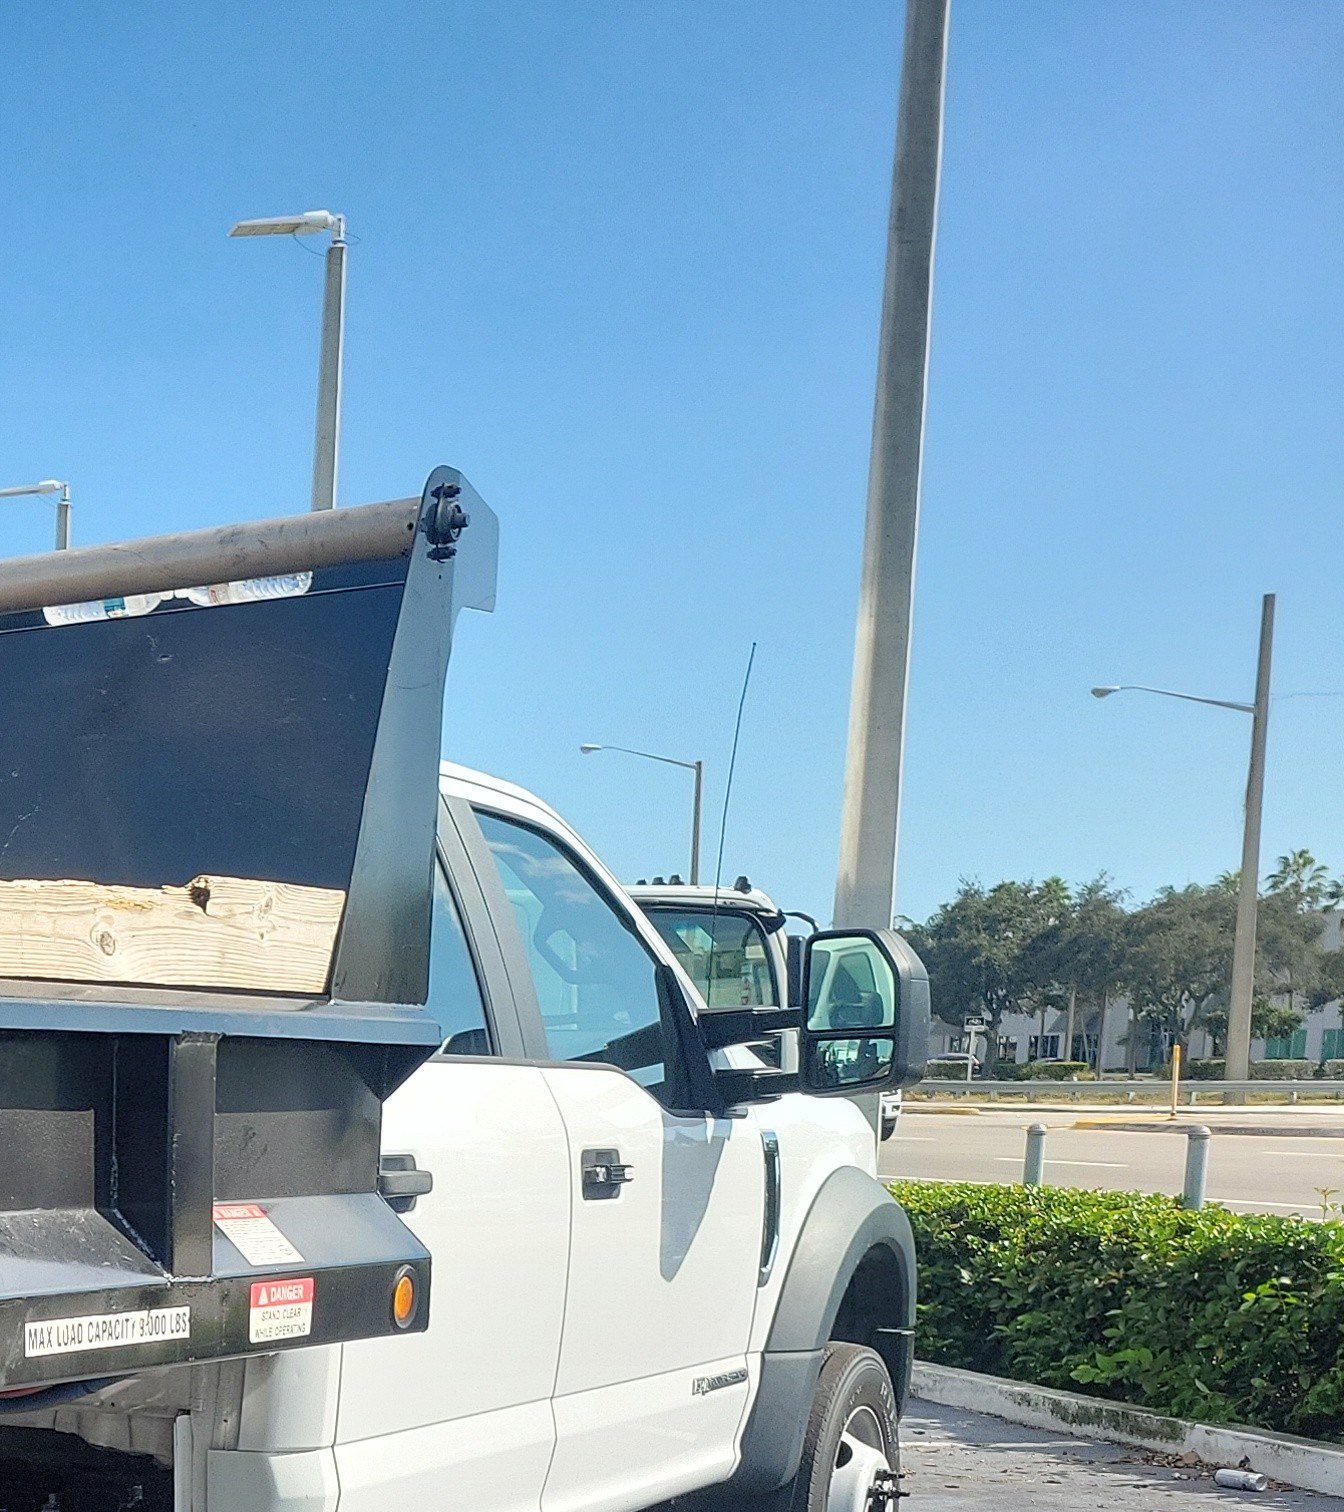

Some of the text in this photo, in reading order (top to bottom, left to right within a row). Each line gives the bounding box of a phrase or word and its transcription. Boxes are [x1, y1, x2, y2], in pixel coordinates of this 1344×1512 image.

[270, 1285, 304, 1302] DANGER
[261, 1308, 301, 1322] STAND CLEAR
[28, 1326, 53, 1350] MAX
[56, 1323, 83, 1347] LOAD
[87, 1318, 136, 1343] CAPACITY
[170, 1312, 187, 1334] LBS
[255, 1323, 306, 1338] WHILE OPERATING
